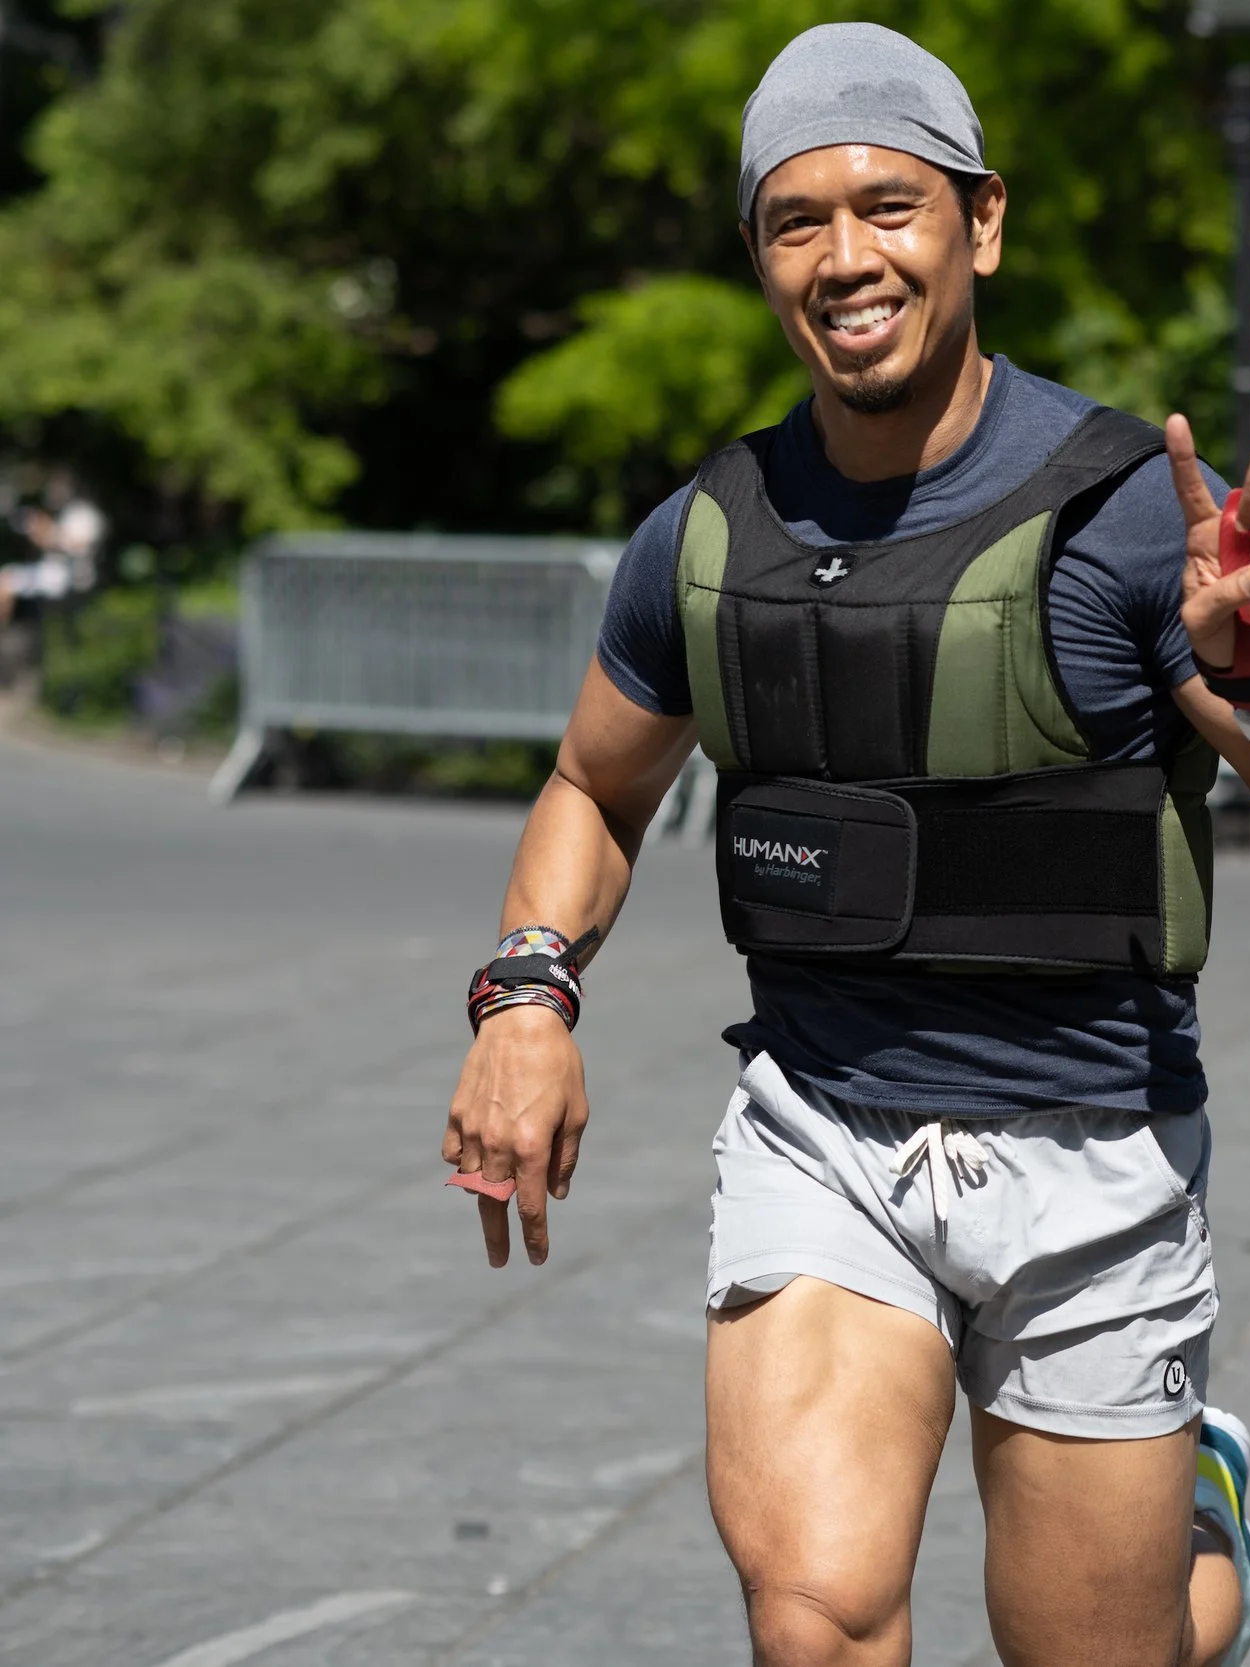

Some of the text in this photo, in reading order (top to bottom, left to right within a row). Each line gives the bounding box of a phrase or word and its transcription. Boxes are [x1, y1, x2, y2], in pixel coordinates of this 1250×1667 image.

[733, 836, 822, 869] HUMANX
[754, 864, 821, 884] by Harbinger
